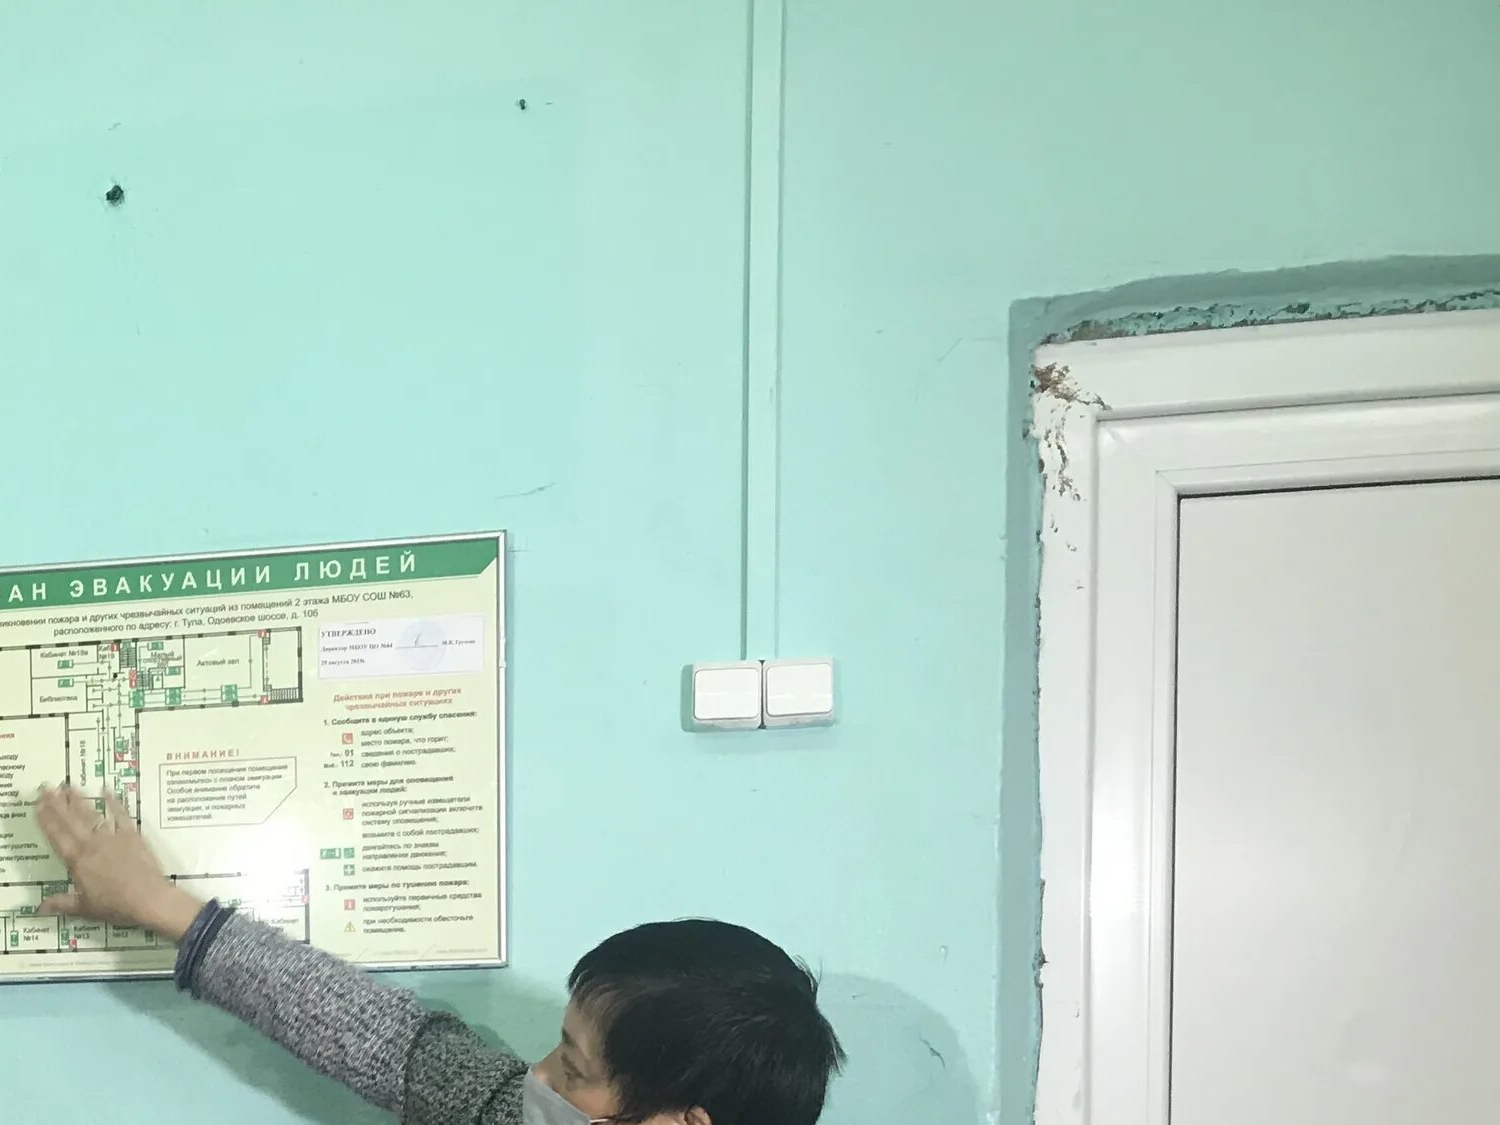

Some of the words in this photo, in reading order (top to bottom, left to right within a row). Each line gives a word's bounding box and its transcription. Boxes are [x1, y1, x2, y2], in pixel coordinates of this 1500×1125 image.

[69, 565, 270, 598] ЭВАКУАЦИИ
[294, 550, 416, 581] ЛЮДЕЙ
[47, 614, 79, 624] пожара
[89, 611, 117, 622] других
[120, 606, 182, 620] чрезвычайных
[185, 604, 224, 615] ситуаций
[240, 598, 291, 610] помещений
[295, 598, 299, 606] 2
[303, 597, 328, 605] этажа
[332, 593, 360, 603] МБОУ
[363, 591, 386, 601] СОШ
[389, 589, 413, 600] №63,
[53, 623, 122, 636] расположенного
[125, 623, 136, 631] по
[139, 620, 171, 630] адресу:
[207, 613, 255, 625] Одоевское
[258, 611, 288, 621] шоссе,
[303, 609, 318, 617] 106
[321, 627, 376, 638] УТВЕРЖДЕНО
[197, 659, 222, 667] Актовый
[39, 694, 77, 703] Библиотека
[333, 693, 372, 702] Действия
[393, 690, 422, 698] пожаре
[432, 687, 461, 695] других
[345, 700, 406, 710] чрезвычайных
[409, 697, 452, 706] ситуациях
[331, 716, 369, 725] Сообщите
[409, 712, 436, 721] службу
[439, 710, 477, 719] спасения:
[166, 748, 239, 760] ВНИМАНИЕ!
[345, 749, 354, 757] 01
[340, 759, 354, 767] 112
[332, 779, 364, 787] Примите
[406, 775, 453, 784] оповещения
[229, 783, 260, 791] обратите
[339, 787, 377, 795] эвакуации
[399, 798, 425, 806] ручные
[361, 808, 396, 816] пожарной
[361, 818, 390, 826] систему
[402, 828, 423, 836] собой
[333, 883, 366, 891] Примите
[438, 879, 469, 887] пожара:
[408, 893, 447, 901] первичные
[449, 892, 482, 900] средства
[23, 926, 49, 934] Кабинет
